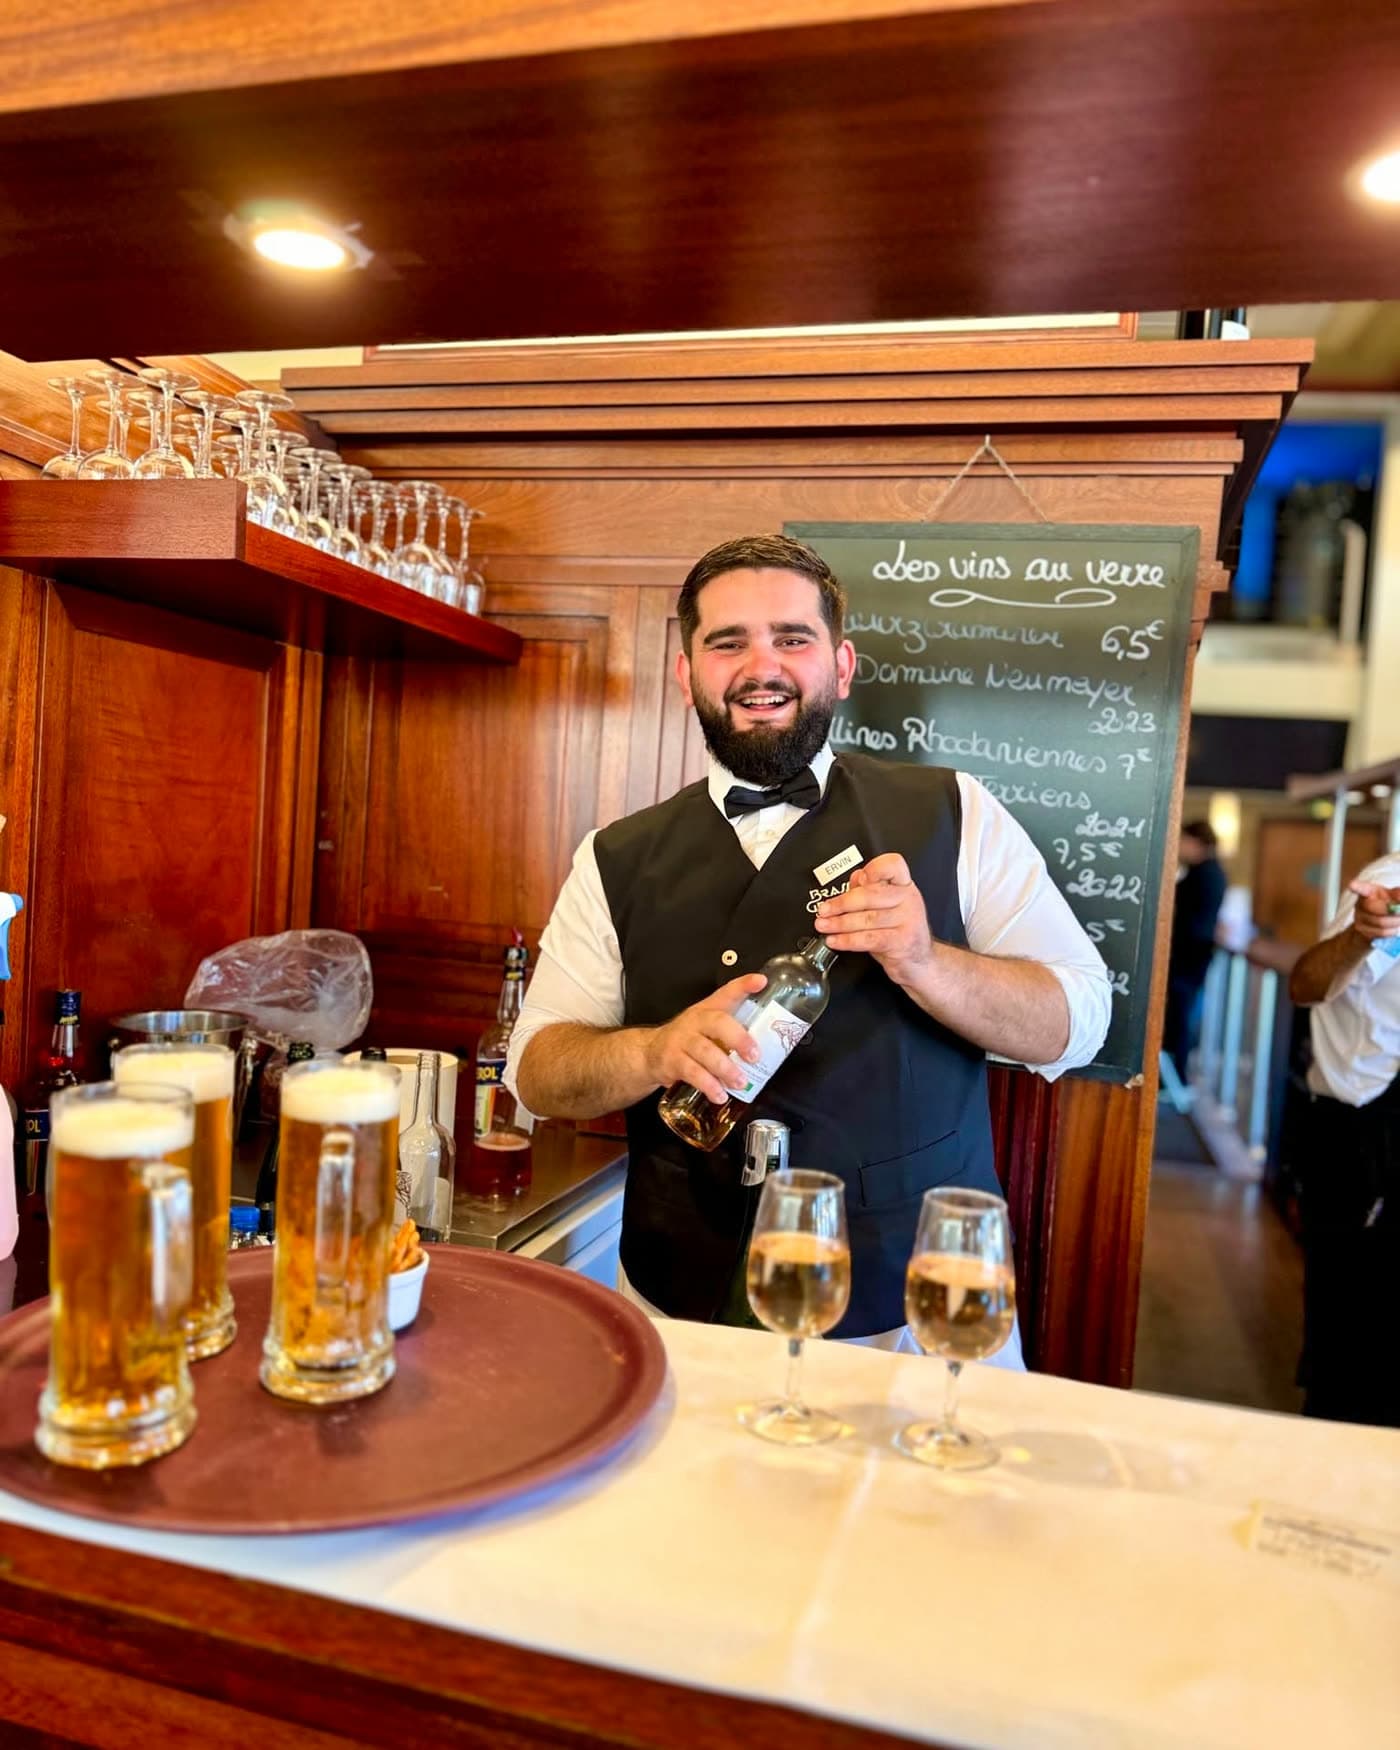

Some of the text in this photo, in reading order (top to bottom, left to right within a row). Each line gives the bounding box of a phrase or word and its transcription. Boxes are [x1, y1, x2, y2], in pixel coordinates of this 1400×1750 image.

[872, 540, 1166, 588] Les vins au verre
[855, 654, 974, 685] Domaine
[1088, 707, 1156, 735] 2023
[1074, 811, 1146, 839] 2021
[824, 855, 852, 876] ERVIN
[1065, 868, 1143, 905] 2022
